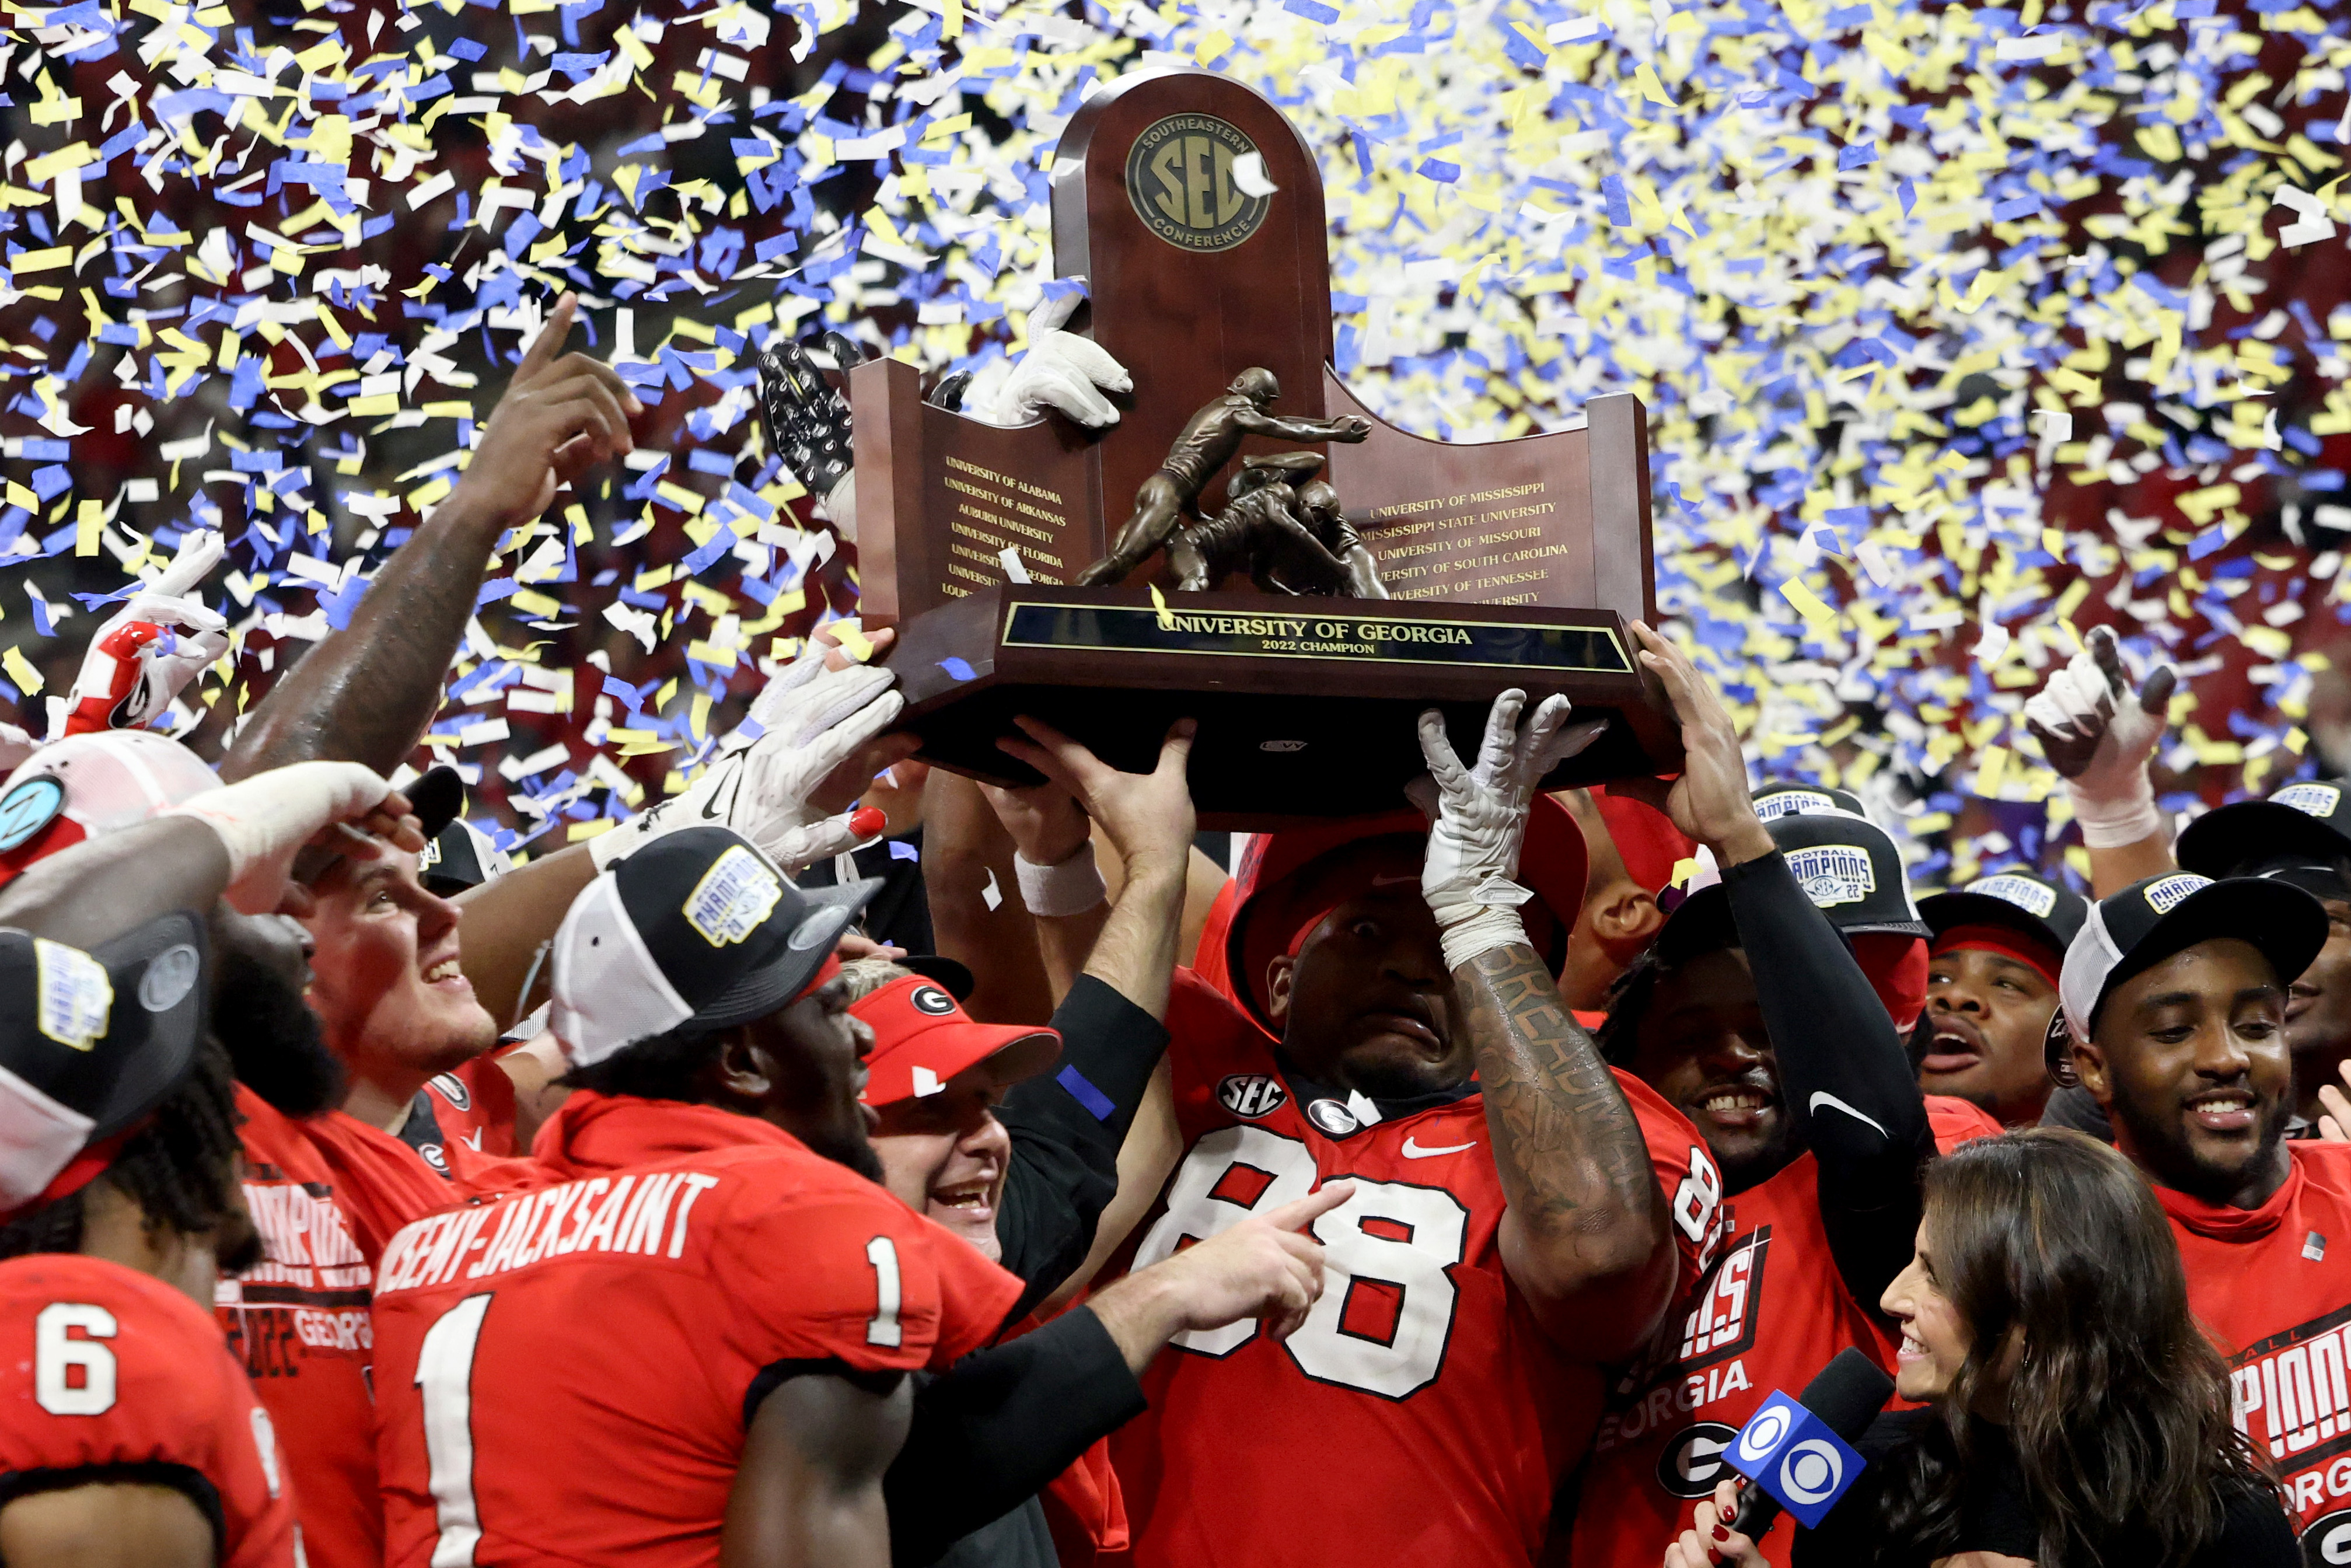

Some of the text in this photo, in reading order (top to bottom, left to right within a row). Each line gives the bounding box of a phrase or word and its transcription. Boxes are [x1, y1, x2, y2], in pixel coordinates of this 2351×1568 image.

[1143, 118, 1249, 153] SOUTHEASTERN
[1150, 136, 1245, 229] SEC
[1154, 218, 1250, 247] CONFERENCE
[945, 456, 1063, 505] UNIVERSITY OF ALABAMA
[944, 477, 1066, 526] UNIVERSITY OF ARKANSAS
[1370, 482, 1545, 519] UNIVERSITY OF MISSISSIPPI
[959, 503, 1054, 543] AUBURN UNIVERSITY
[1360, 502, 1556, 542] MISSISSIPPI STATE UNIVERSITY
[951, 522, 1006, 549] UNIVERSITY
[1023, 546, 1063, 568] FLORIDA
[1378, 526, 1541, 561] UNIVERSITY OF MISSOURI
[1433, 562, 1451, 575] OF
[1454, 554, 1499, 572] SOUTH
[1503, 544, 1569, 563] CAROLINA
[948, 564, 1001, 586] UNIVERSIT
[1390, 568, 1549, 600] IVERSITY OF TENNESSEE
[1157, 616, 1473, 645] UNIVERSITY OF GEORGIA
[1262, 640, 1375, 655] 2022 CHAMPION
[1756, 795, 1819, 808] OOTBALL
[1792, 856, 1871, 889] AMPIONS
[1846, 884, 1860, 899] 22
[1222, 1075, 1283, 1115] SEC
[1127, 1122, 1471, 1403] 88
[866, 1235, 902, 1348] 1
[36, 1302, 117, 1416] 6
[414, 1291, 496, 1568] 1
